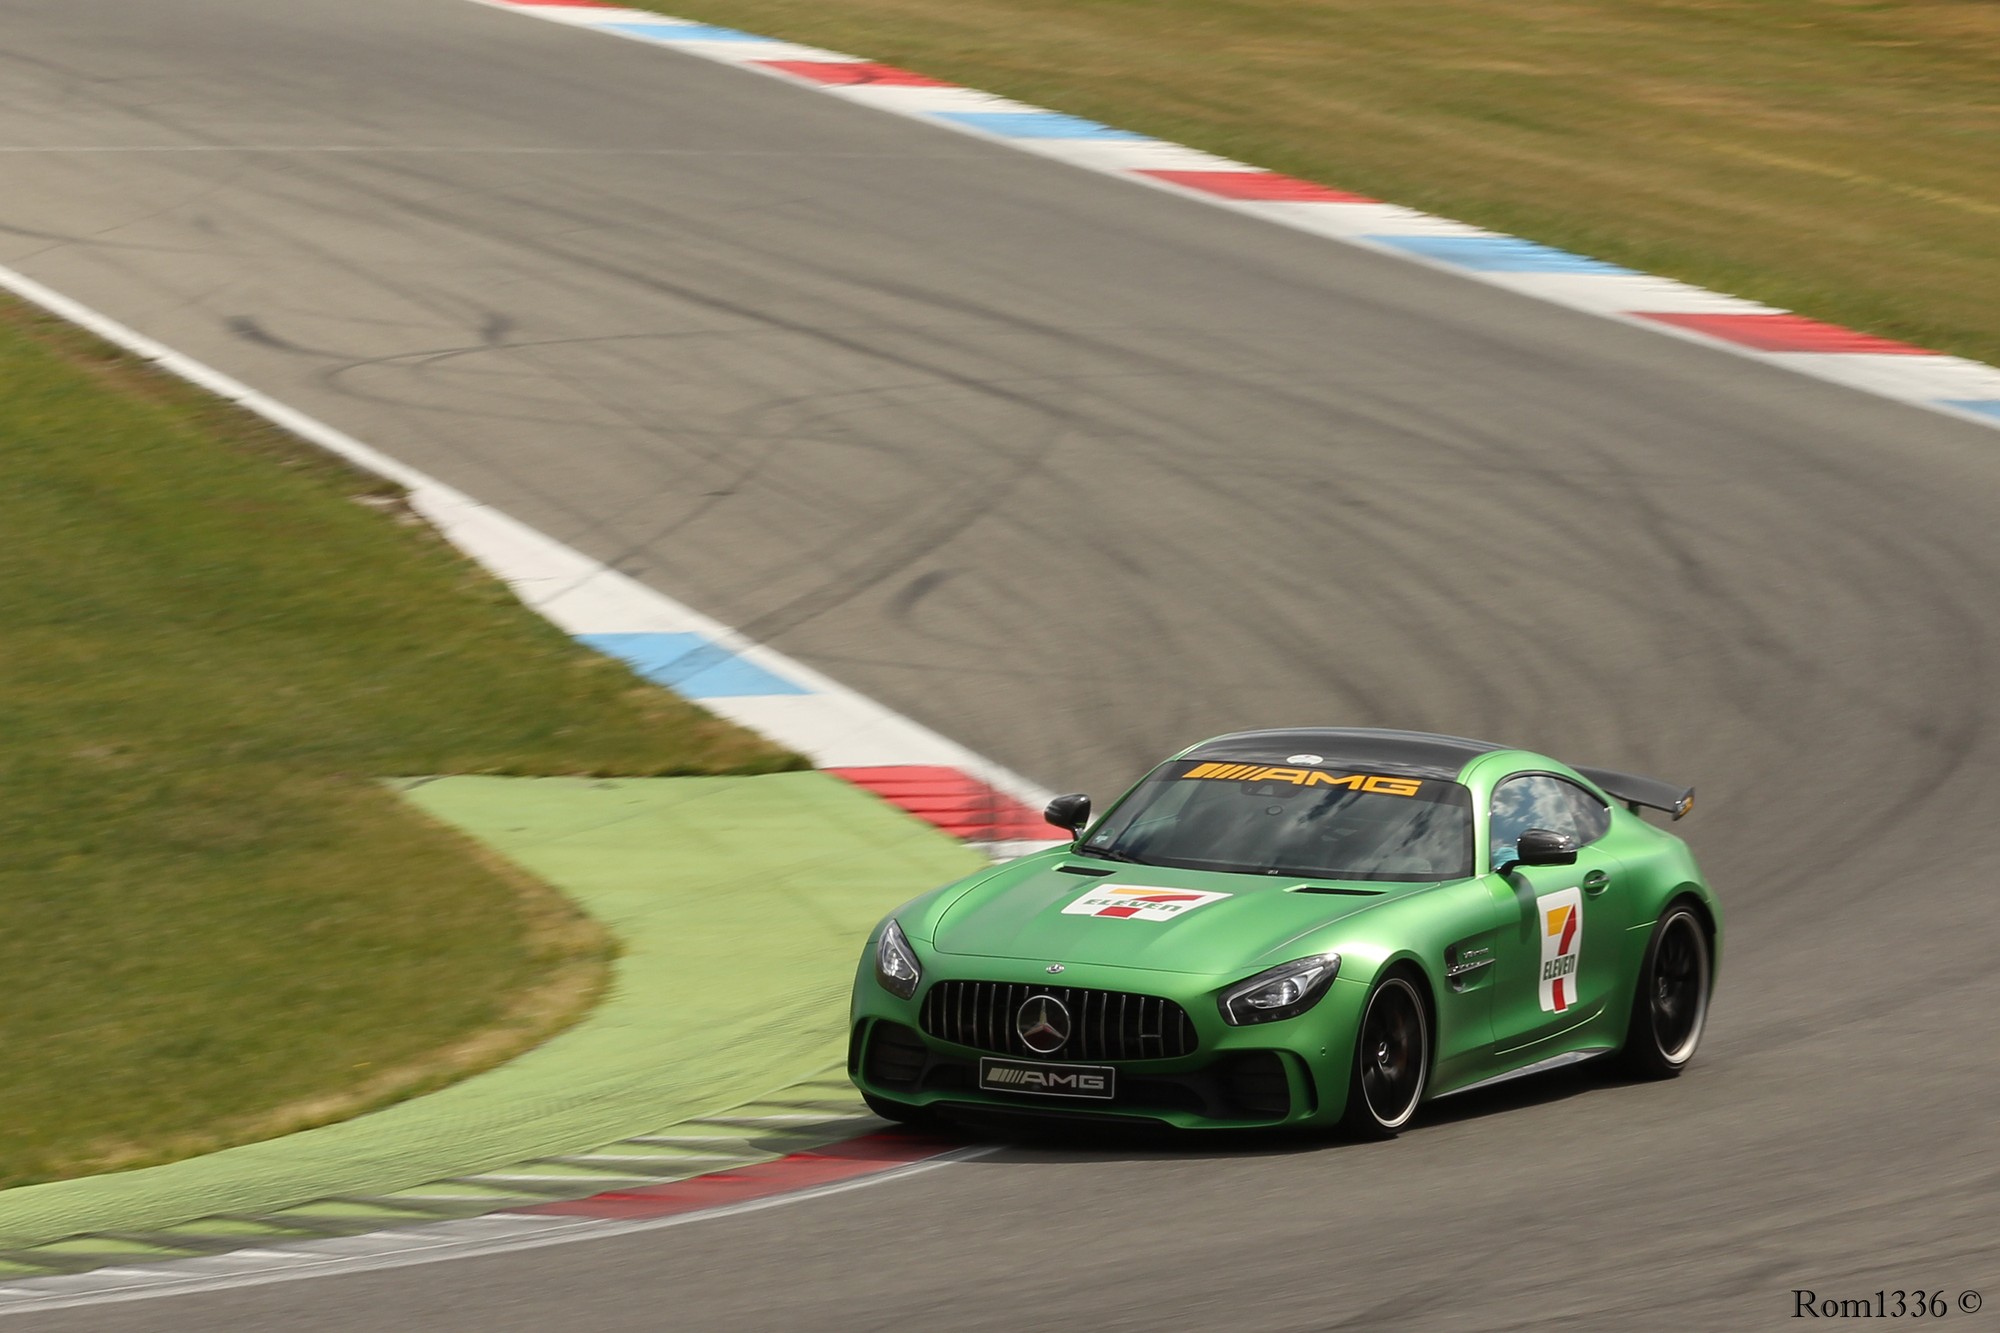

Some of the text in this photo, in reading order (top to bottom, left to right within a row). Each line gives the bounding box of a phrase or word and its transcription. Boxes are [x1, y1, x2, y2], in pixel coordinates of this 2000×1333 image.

[1249, 767, 1423, 797] AMG
[1107, 888, 1207, 918] 7
[1546, 903, 1577, 1012] 7
[1020, 1070, 1105, 1090] AMG
